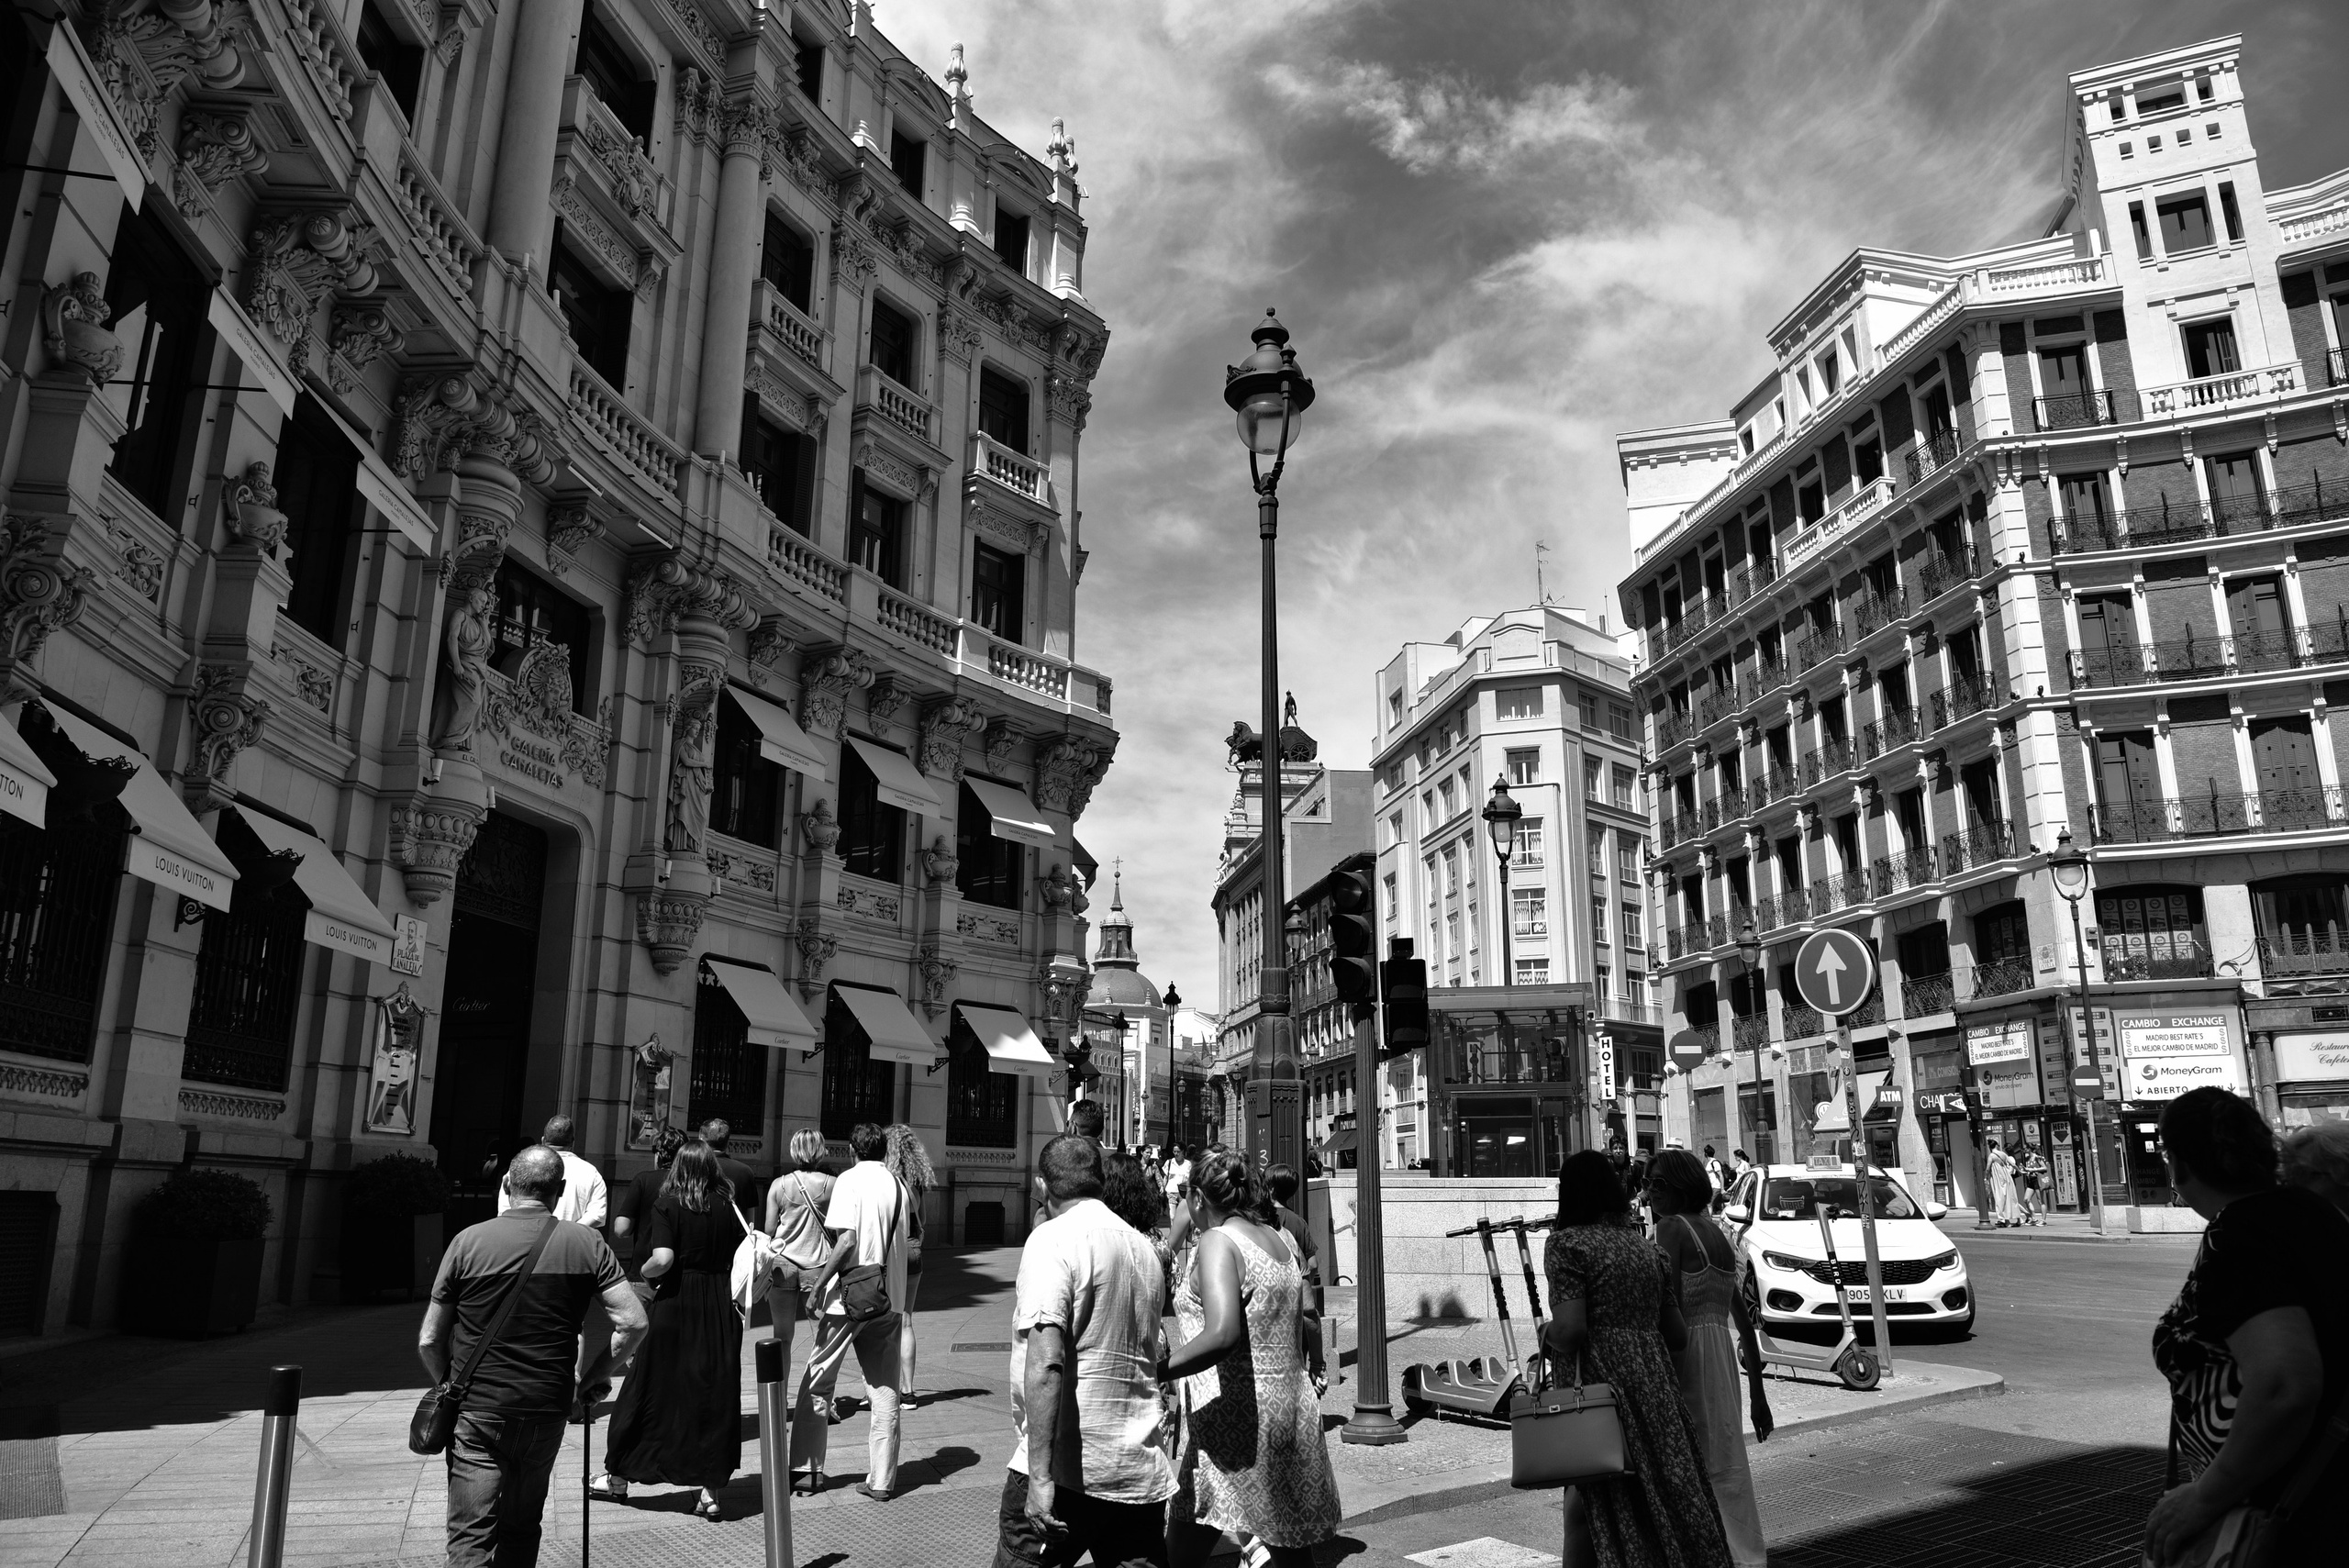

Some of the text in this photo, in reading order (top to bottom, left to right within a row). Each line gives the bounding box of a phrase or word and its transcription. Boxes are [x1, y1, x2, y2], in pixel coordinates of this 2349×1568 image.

[98, 113, 125, 160] CANALEJAS
[253, 349, 275, 380] CANALEJAS
[511, 737, 555, 767] GALERÍA
[500, 751, 563, 789] CANALEJAS
[155, 855, 215, 893] LOUIS VUITTON
[326, 925, 377, 951] LOUIS VUITTON
[396, 949, 415, 962] PLAZA
[393, 957, 422, 974] CANALEJAS
[452, 996, 491, 1011] Cartier
[2121, 1017, 2225, 1029] CAMBIO EXCHANGE
[1967, 1022, 2026, 1039] CAMBIO EXCHANGE
[774, 1036, 790, 1044] Cartier
[1981, 1040, 1994, 1049] MADRID
[2195, 1042, 2219, 1051] MADRID
[896, 1051, 910, 1060] Cartier
[1980, 1051, 1991, 1060] MEJOR
[1013, 1064, 1029, 1073] Cartier
[1601, 1039, 1612, 1097] HOTEL
[2161, 1066, 2222, 1076] MoneyGram
[1995, 1072, 2033, 1084] MoneyGram
[2147, 1086, 2188, 1095] ABIERTO
[1880, 1091, 1902, 1103] ATM
[2053, 1122, 2069, 1130] HERE
[1814, 1157, 1831, 1166] TAXI
[1781, 1201, 1805, 1210] LIBRE
[1830, 1258, 1842, 1284] BIRD
[1884, 1289, 1903, 1300] KLV
